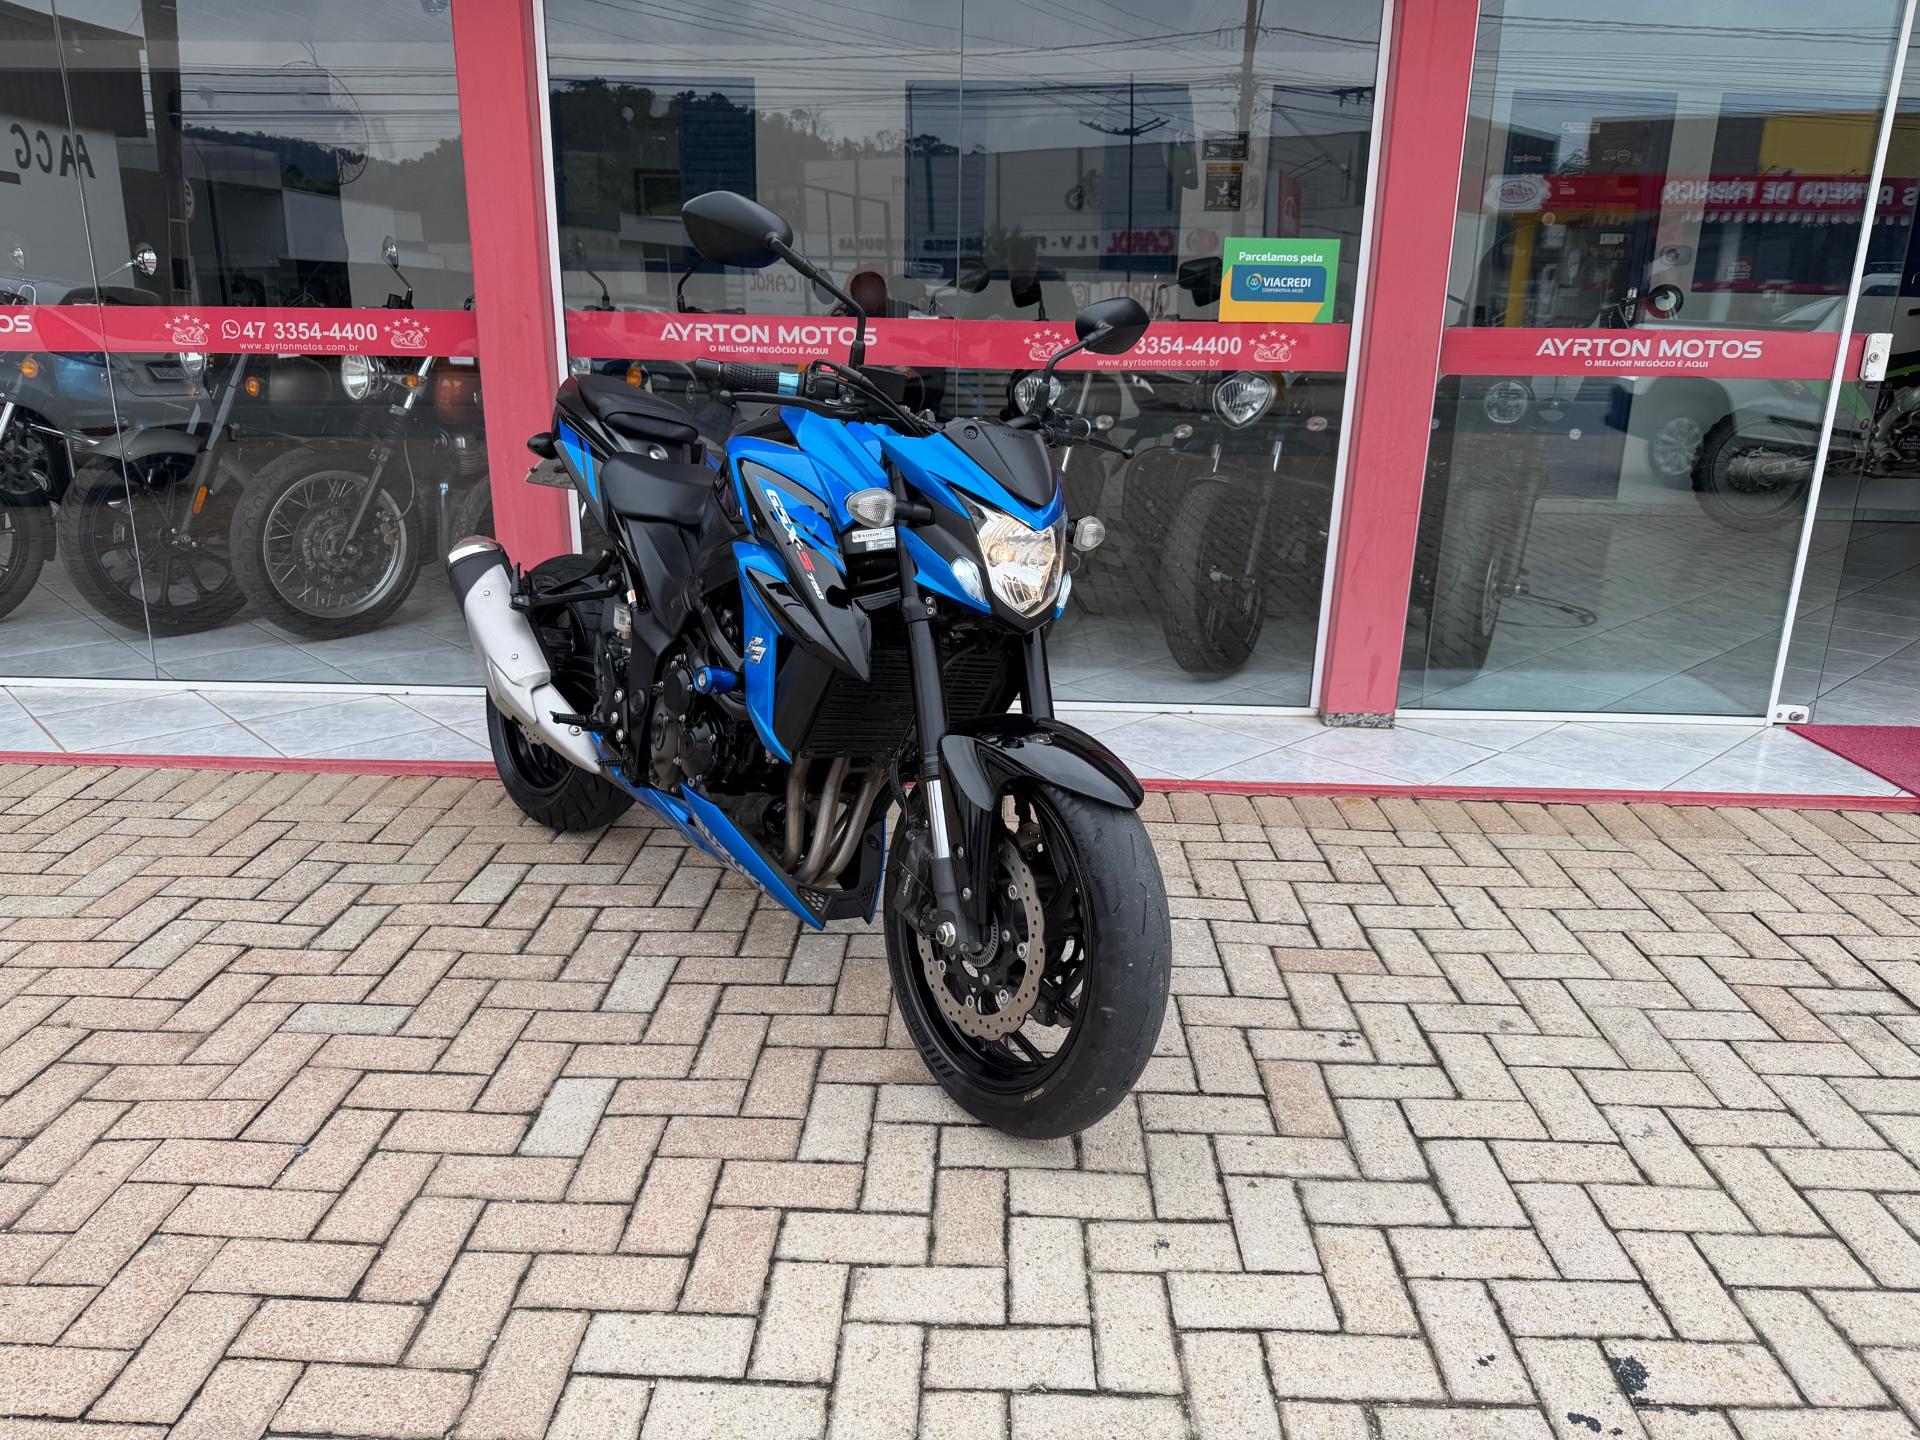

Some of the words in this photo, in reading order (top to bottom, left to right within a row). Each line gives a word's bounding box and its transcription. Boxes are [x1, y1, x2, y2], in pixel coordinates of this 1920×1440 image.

[1239, 252, 1299, 262] Parcelamos
[1300, 253, 1323, 264] pela
[1263, 277, 1312, 288] VIACREDI
[242, 321, 266, 339] 47
[274, 321, 378, 341] 3354-4400
[660, 322, 771, 345] AYRTON
[777, 325, 878, 346] MOTOS
[240, 342, 359, 352] www.ayrtonmotos.com.br
[709, 345, 717, 353] O
[719, 345, 755, 353] MELHOR
[757, 344, 797, 355] NEGÓCIO
[806, 347, 829, 356] AQUI
[1134, 335, 1243, 355] 3354-4400
[1536, 337, 1652, 358] AYRTON
[1658, 338, 1764, 359] MOTOS
[1097, 358, 1220, 369] www.ayrtonmotos.com.br
[1585, 359, 1592, 368] O
[1594, 359, 1632, 368] MELHOR
[1634, 357, 1676, 368] NEGÓCIO
[1685, 359, 1709, 369] AQUI
